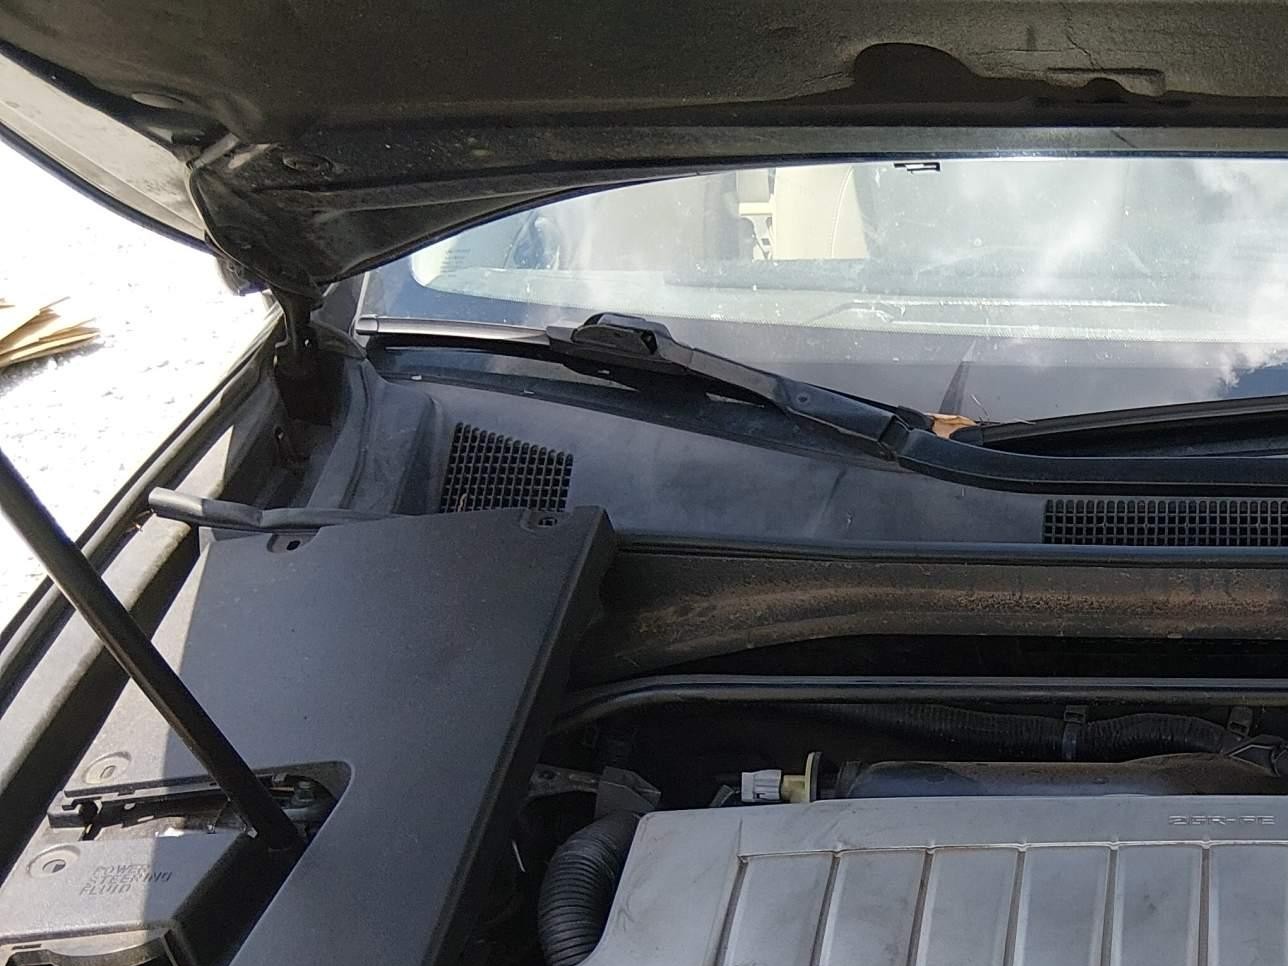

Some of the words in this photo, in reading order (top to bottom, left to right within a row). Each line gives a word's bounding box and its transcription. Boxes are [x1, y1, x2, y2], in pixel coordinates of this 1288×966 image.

[93, 864, 151, 876] POWER
[89, 871, 173, 884] STEERING
[79, 883, 132, 896] FLUID
